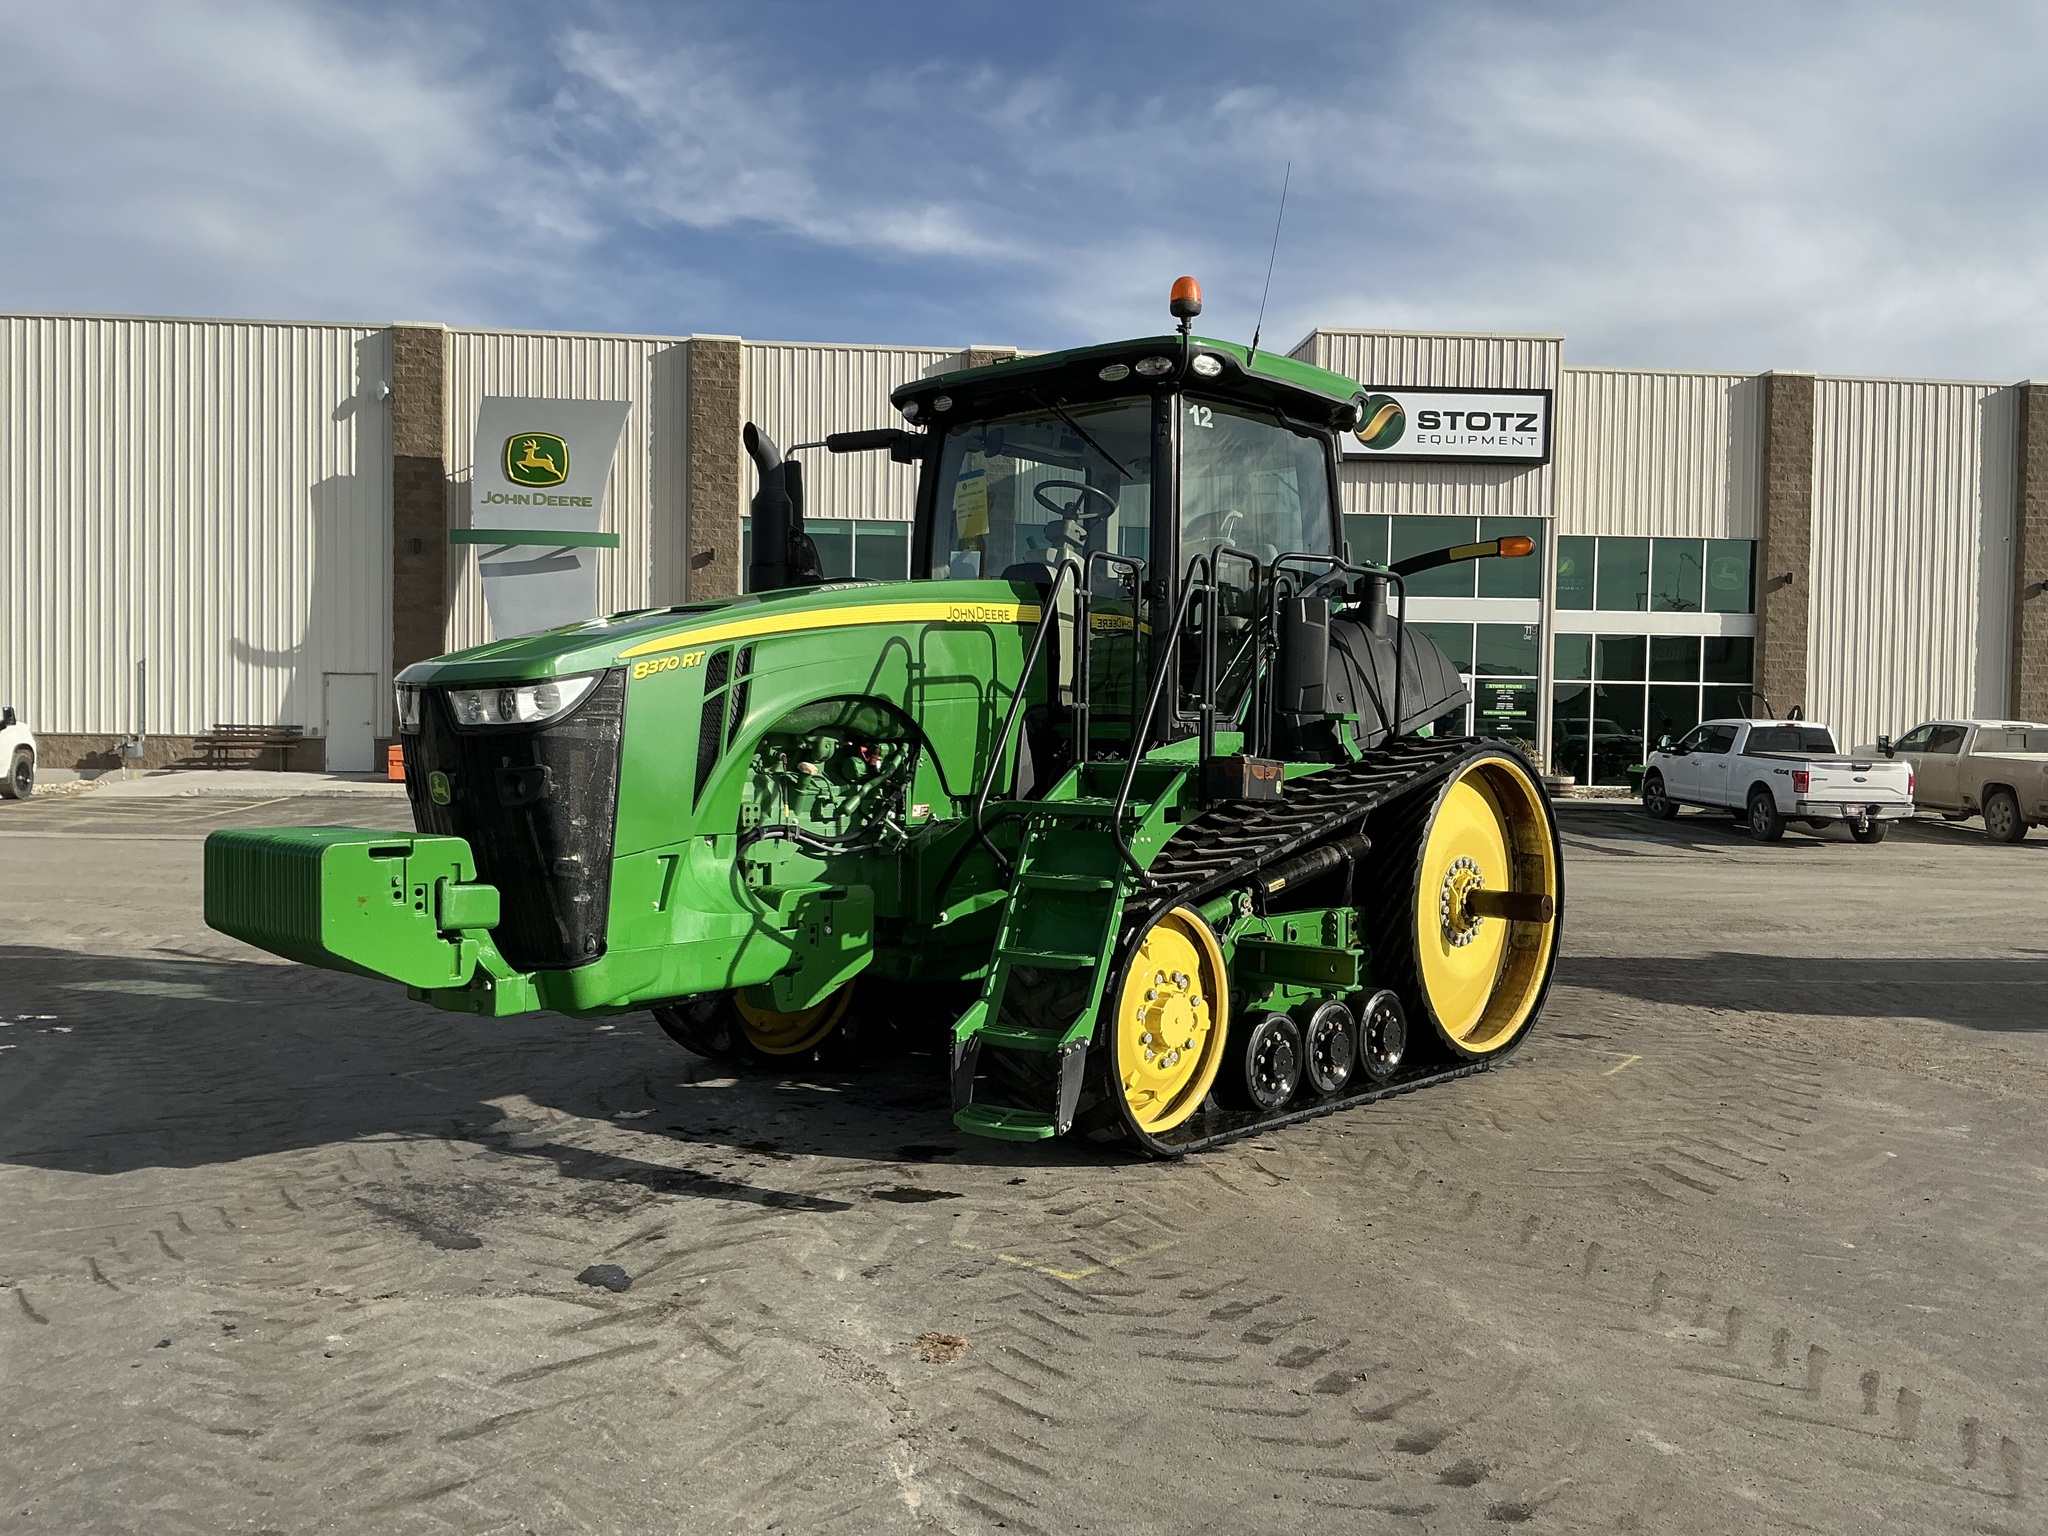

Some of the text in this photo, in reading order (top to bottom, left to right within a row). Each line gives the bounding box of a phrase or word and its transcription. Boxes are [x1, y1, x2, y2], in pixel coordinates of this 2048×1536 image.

[1189, 405, 1213, 428] 12
[1418, 411, 1538, 432] STOTZ
[1417, 435, 1537, 445] EQUIPMENT
[481, 491, 592, 507] JOHN DEERE
[946, 606, 1010, 620] JOHN DEERE
[633, 650, 706, 680] 8370 RT
